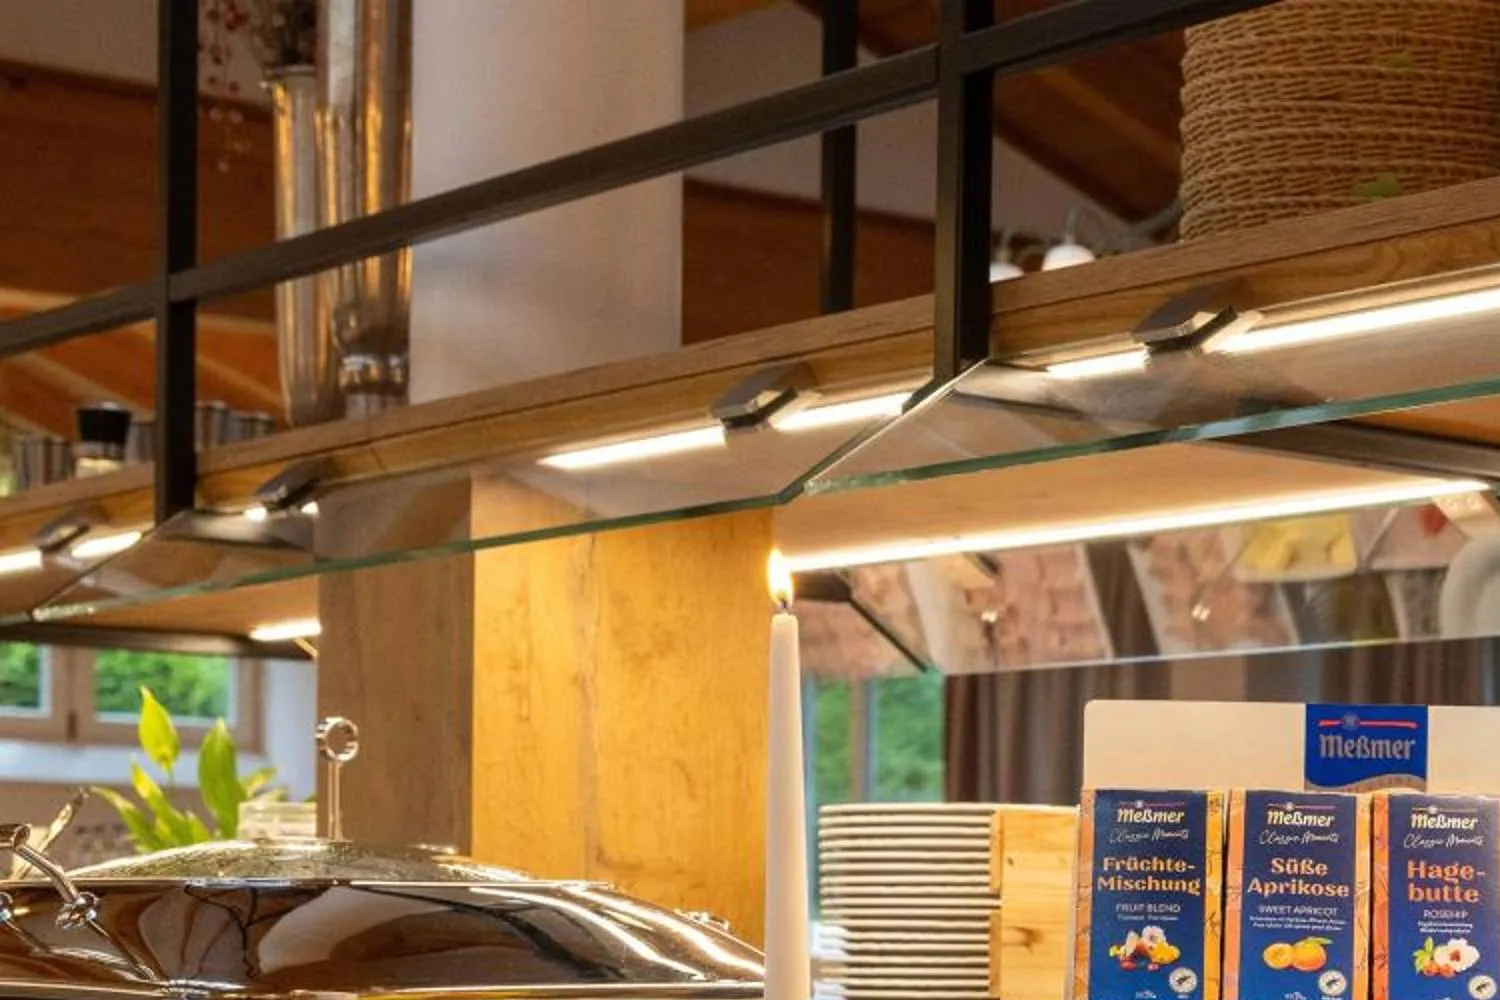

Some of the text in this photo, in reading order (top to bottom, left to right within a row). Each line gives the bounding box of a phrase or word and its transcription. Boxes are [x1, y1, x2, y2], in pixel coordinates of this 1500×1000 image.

[1319, 733, 1417, 759] Meßmer
[1117, 808, 1185, 823] Meßmer
[1267, 810, 1335, 827] Meßmer
[1411, 814, 1479, 830] Meßmer
[1103, 856, 1196, 873] Früchte-
[1271, 858, 1329, 877] Süße
[1407, 860, 1486, 884] Hage-
[1097, 875, 1201, 897] Mischung
[1248, 877, 1349, 898] Aprikose
[1407, 883, 1480, 903] butte
